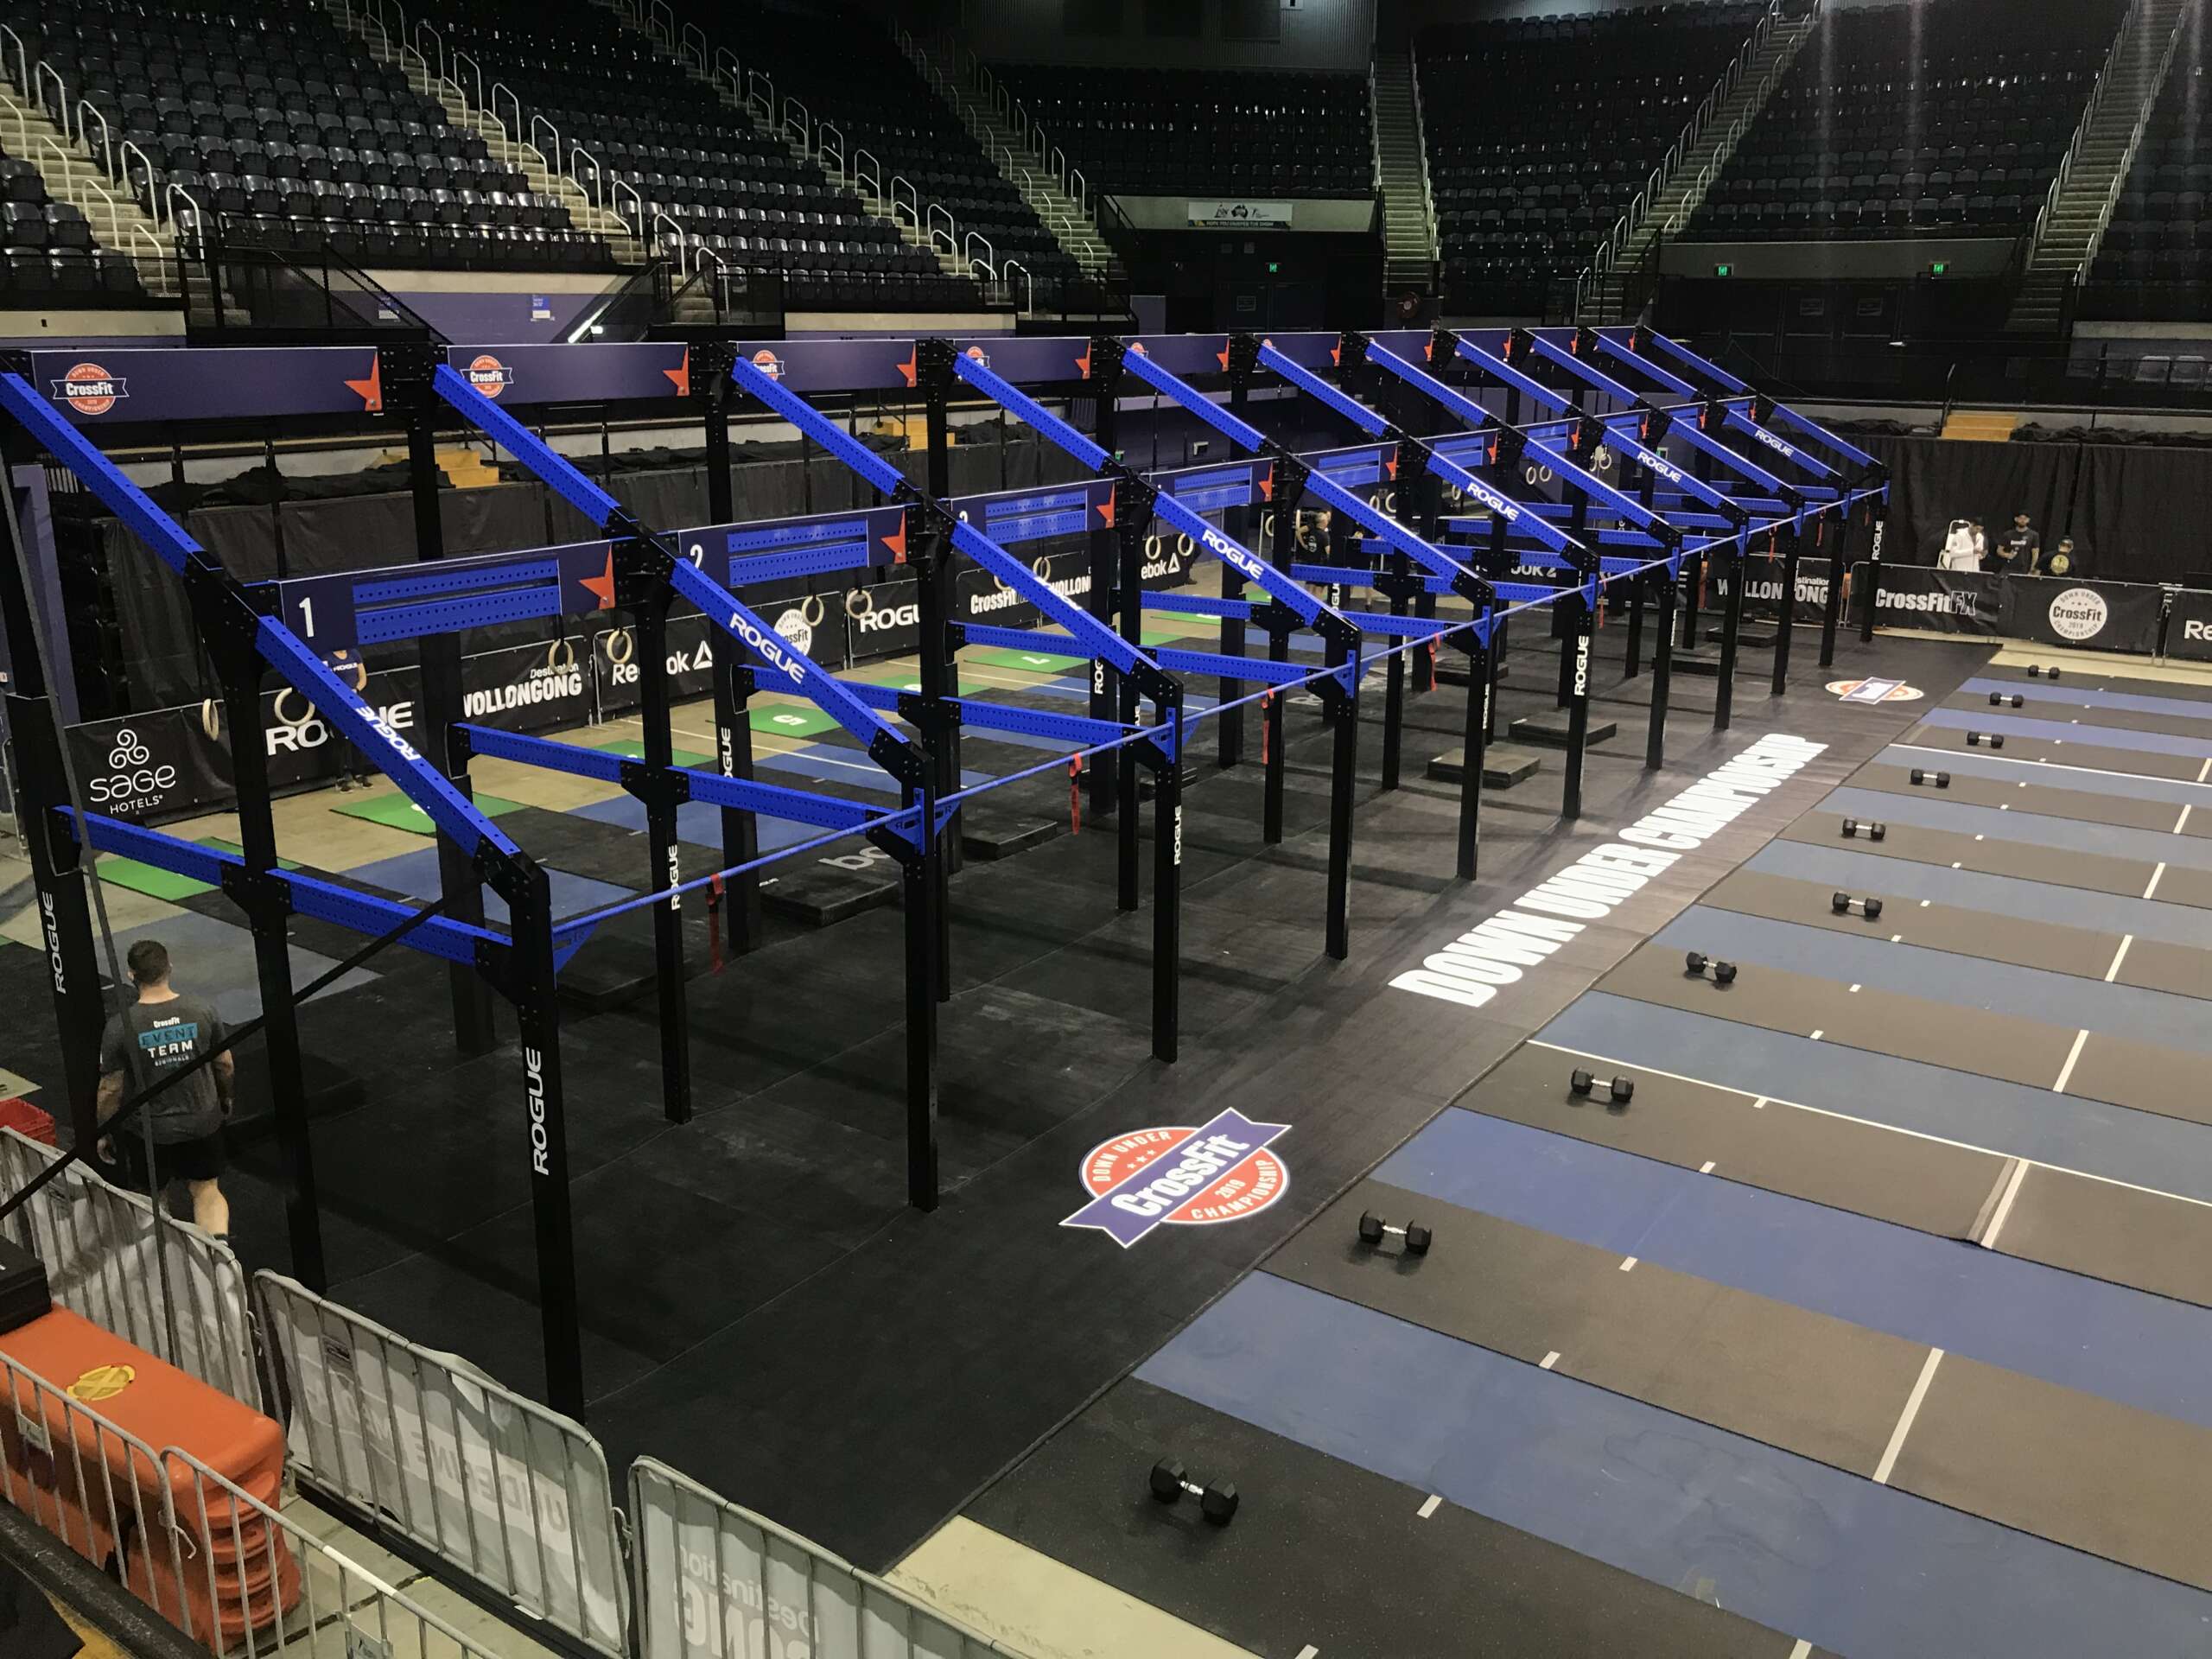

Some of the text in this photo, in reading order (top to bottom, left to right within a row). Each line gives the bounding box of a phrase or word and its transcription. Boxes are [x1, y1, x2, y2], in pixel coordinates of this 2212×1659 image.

[65, 381, 114, 397] CrossFit
[470, 370, 504, 384] CrossFit
[1754, 429, 1794, 457] ROGUE
[1637, 451, 1682, 483] ROGUE
[1466, 482, 1520, 522] ROGUE
[1202, 529, 1264, 580] ROGUE
[1871, 520, 1884, 560] ROGUE
[298, 596, 315, 638] 1
[2053, 606, 2102, 622] CrossFit
[729, 612, 806, 684] ROGUE
[783, 629, 809, 644] ossFit
[612, 651, 690, 685] Reok
[1574, 635, 1590, 696] ROGUE
[355, 705, 422, 761] ROGUE
[110, 795, 161, 815] HOTELS
[1173, 804, 1182, 866] ROGUE
[1388, 733, 1830, 1008] DOWN UNDER CHAMPIONSHIP
[41, 891, 67, 995] ROGUE
[142, 1026, 194, 1046] EVENT
[153, 1016, 181, 1029] CrossFit
[147, 1039, 194, 1059] TEAM
[525, 1046, 550, 1176] ROGUE
[1092, 1130, 1173, 1182] DOWN UNDER
[1111, 1134, 1250, 1217] CrossFit
[1191, 1159, 1278, 1221] CHAMPIONSHIP
[1215, 1179, 1247, 1199] 2019
